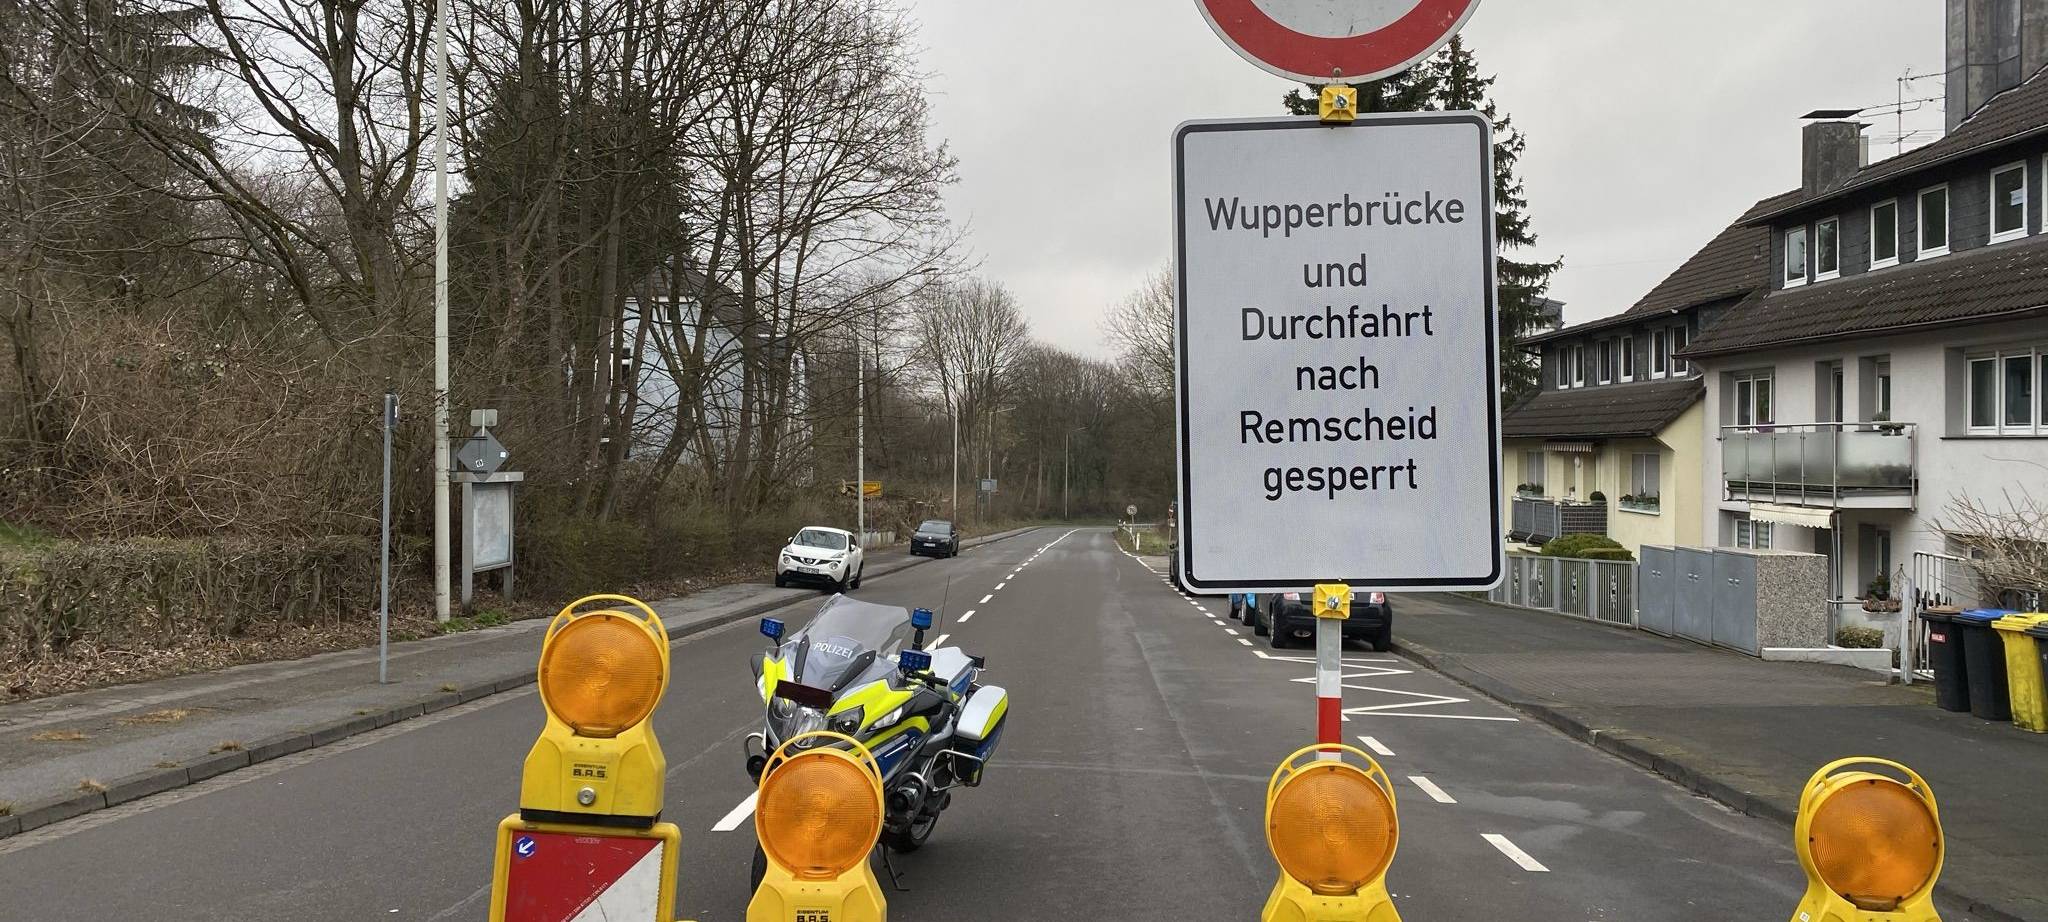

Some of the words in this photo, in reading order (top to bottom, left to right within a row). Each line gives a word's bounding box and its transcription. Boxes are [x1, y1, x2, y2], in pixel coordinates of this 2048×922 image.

[1204, 190, 1465, 238] Wupperbrücke
[1303, 252, 1367, 289] und
[1241, 303, 1434, 341] Durchfahrt
[1296, 355, 1380, 391] nach
[1240, 405, 1438, 444] Remscheid
[1263, 458, 1418, 502] gesperrt
[813, 642, 854, 659] POLIZEI
